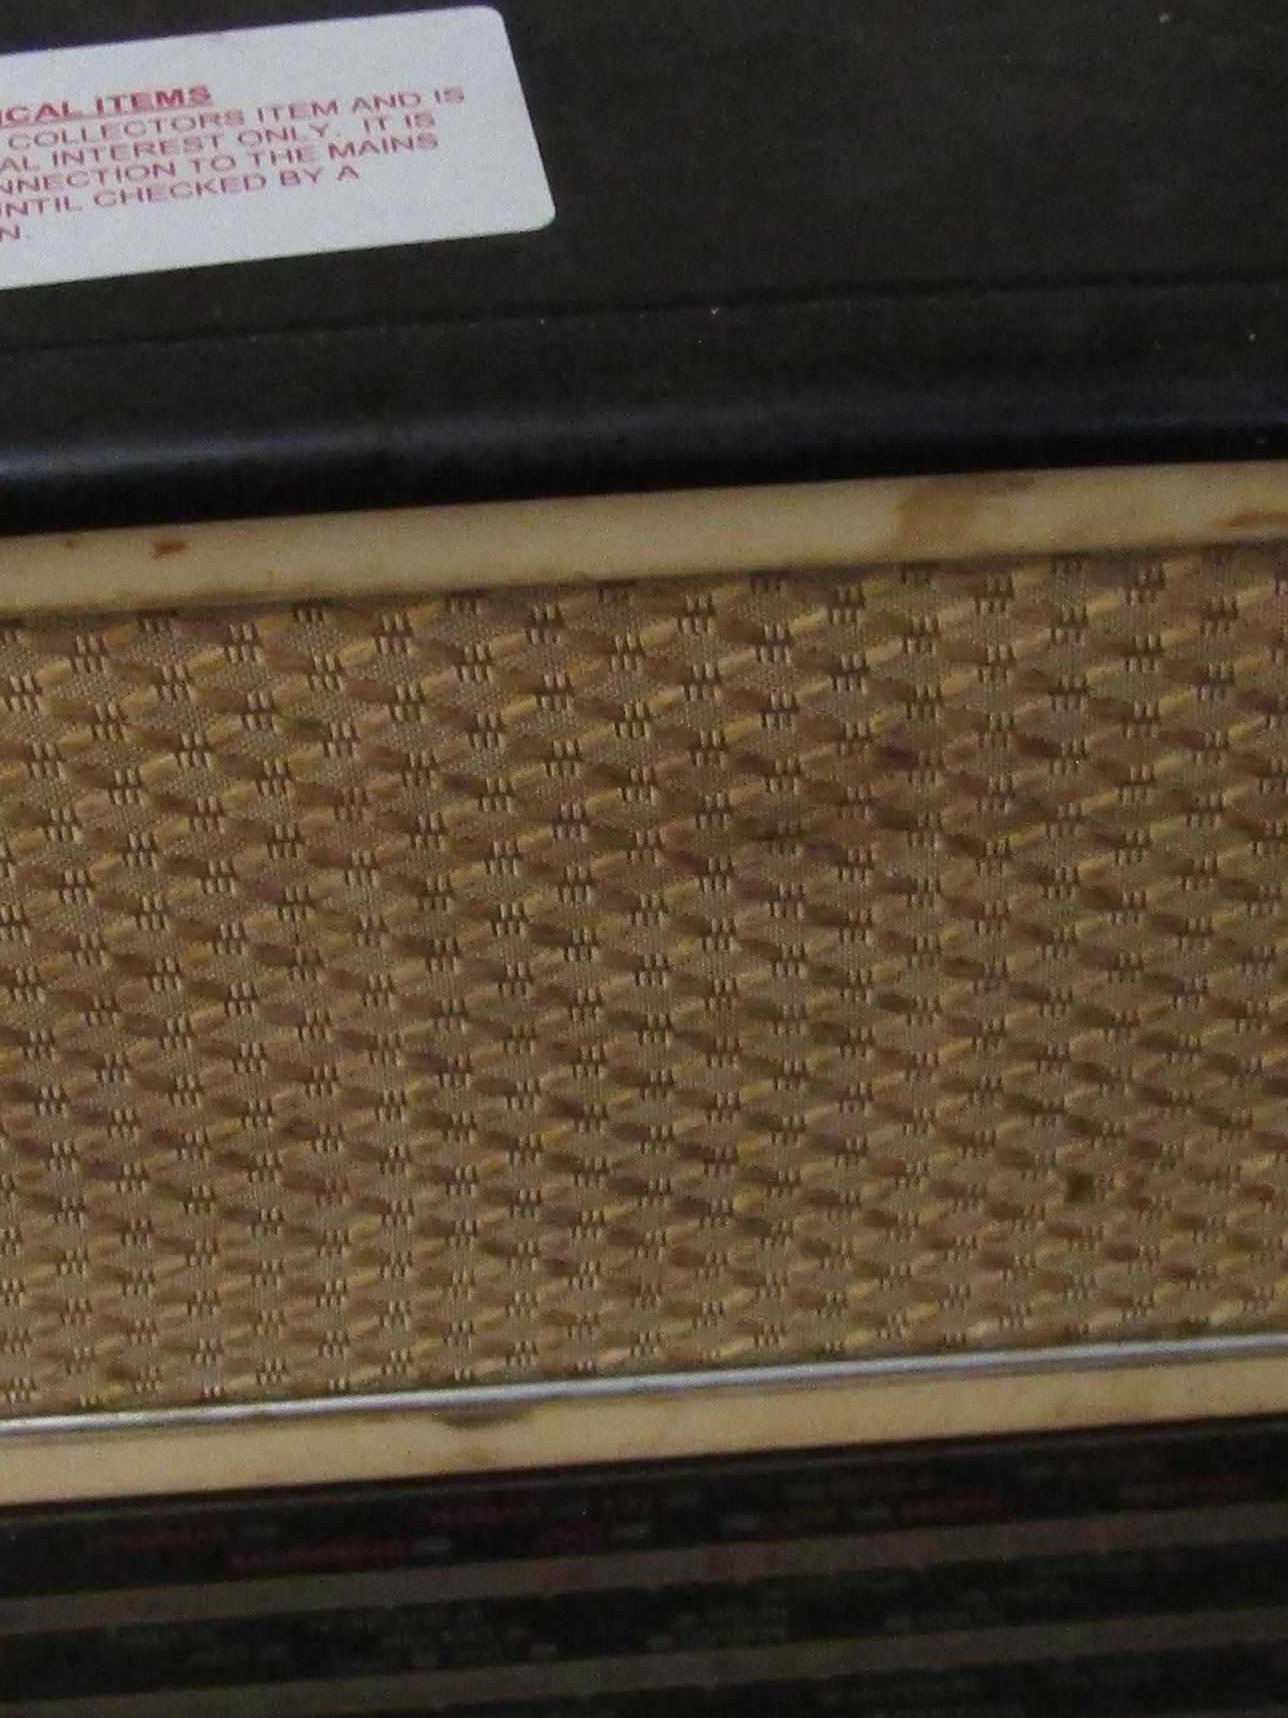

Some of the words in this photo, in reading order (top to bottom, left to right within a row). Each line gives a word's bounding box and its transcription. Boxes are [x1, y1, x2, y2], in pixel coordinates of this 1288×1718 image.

[8, 108, 246, 151] COLLECTORS
[256, 98, 339, 124] ITEM
[351, 91, 422, 113] AND
[432, 85, 465, 105] IS
[94, 84, 213, 115] ITEMS
[52, 131, 224, 167] INTEREST
[237, 121, 341, 146] ONLY.
[362, 115, 392, 135] IT
[404, 111, 435, 130] IS
[190, 154, 236, 175] TO
[252, 145, 315, 166] THE
[328, 131, 439, 161] MAINS
[93, 171, 267, 208] CHECKED
[278, 165, 325, 188] BY
[336, 162, 361, 182] A
